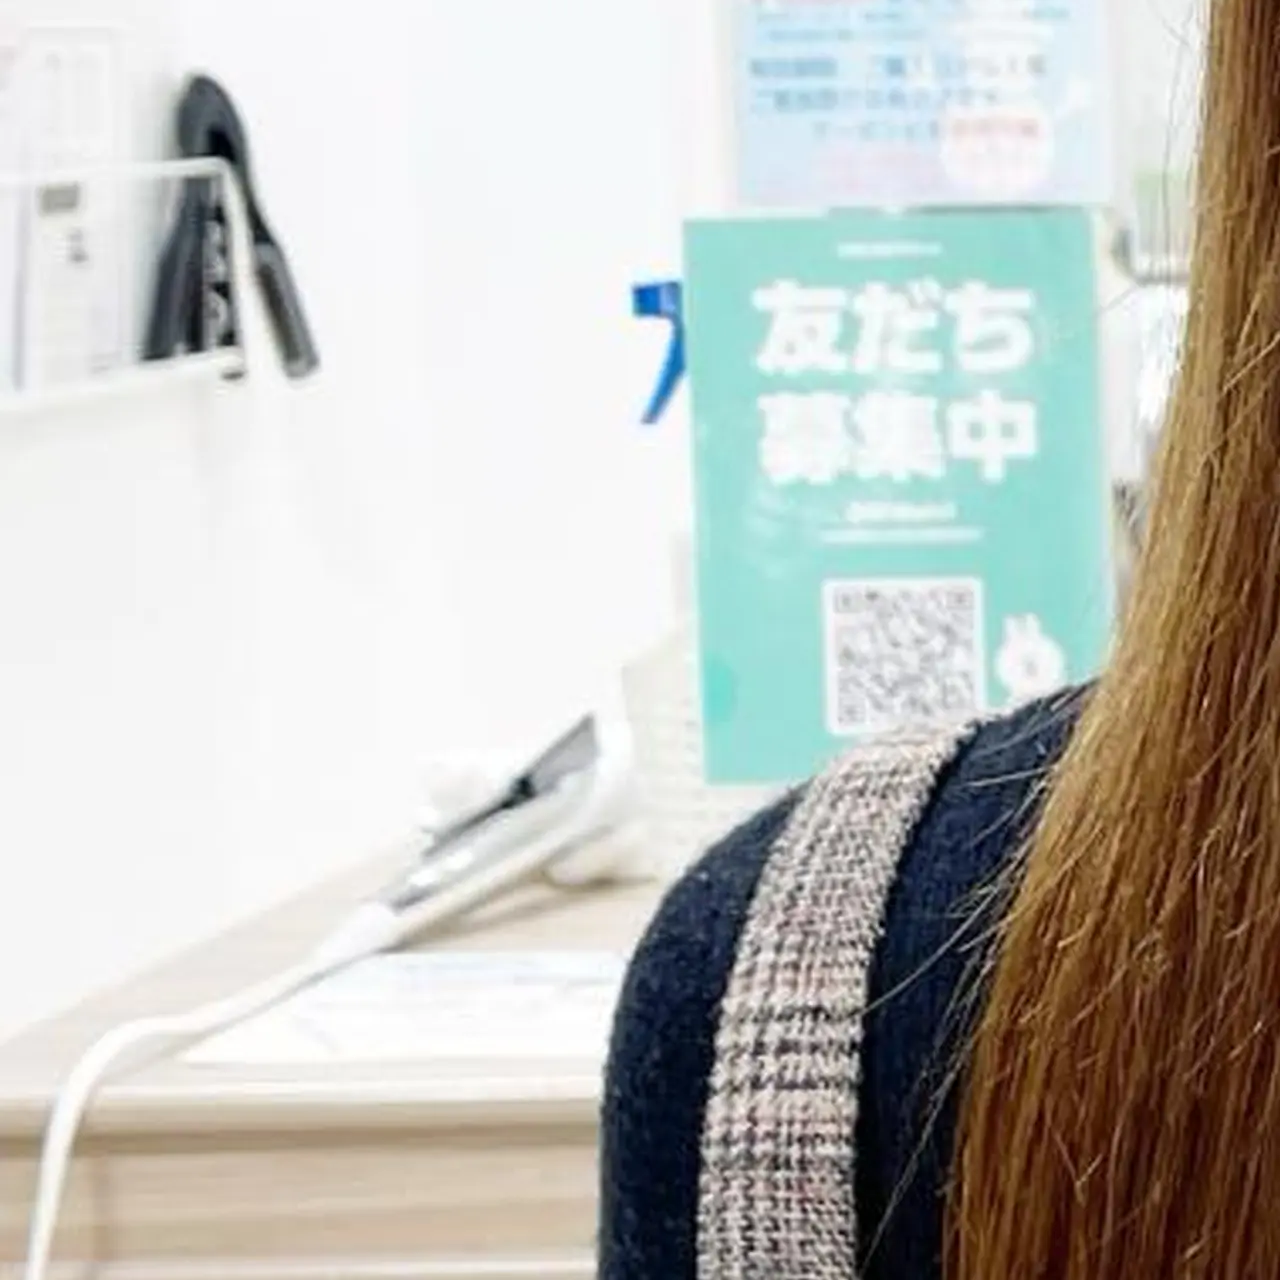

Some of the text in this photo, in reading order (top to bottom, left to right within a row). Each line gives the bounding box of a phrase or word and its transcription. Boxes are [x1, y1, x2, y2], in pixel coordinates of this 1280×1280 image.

[752, 277, 1036, 376] 友だち
[756, 389, 1038, 485] 募集中
